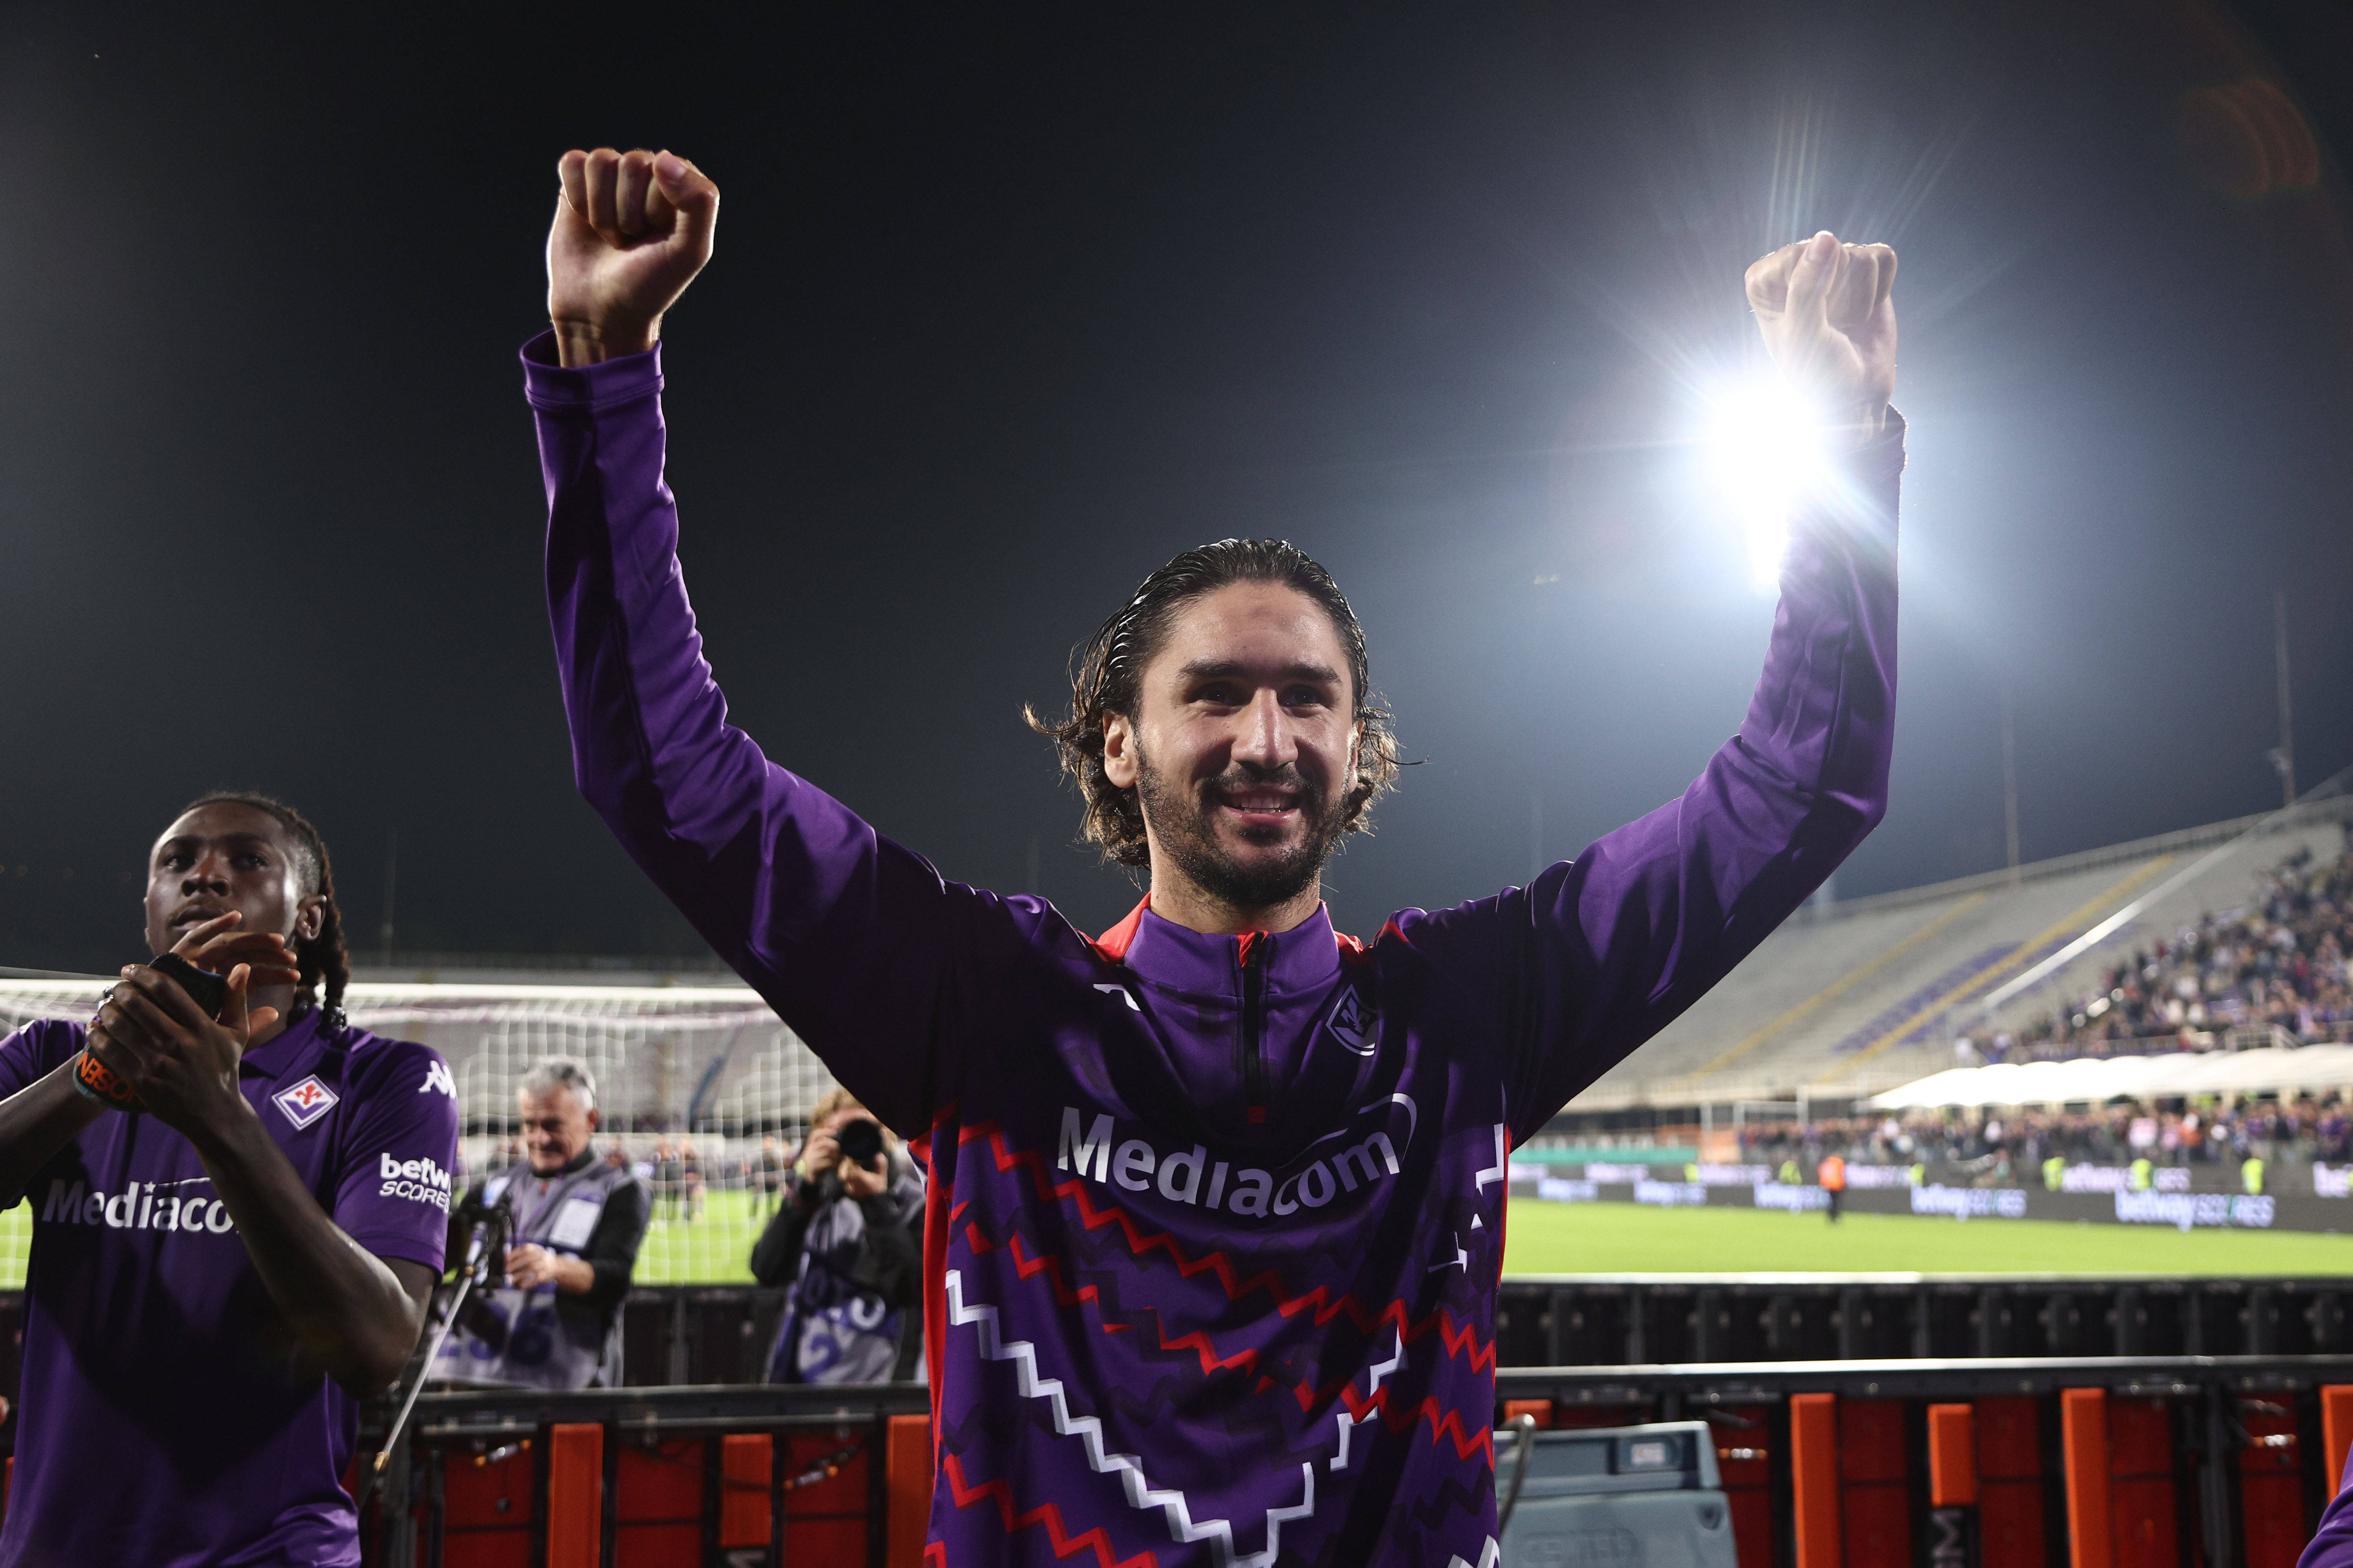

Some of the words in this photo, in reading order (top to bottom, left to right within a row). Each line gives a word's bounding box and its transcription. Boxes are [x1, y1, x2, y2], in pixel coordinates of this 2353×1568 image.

[78, 1052, 133, 1103] OSEN
[380, 1152, 452, 1197] betw
[1057, 1106, 1400, 1219] Mediacom
[42, 1179, 235, 1234] Mediaco
[379, 1180, 450, 1214] SCORES
